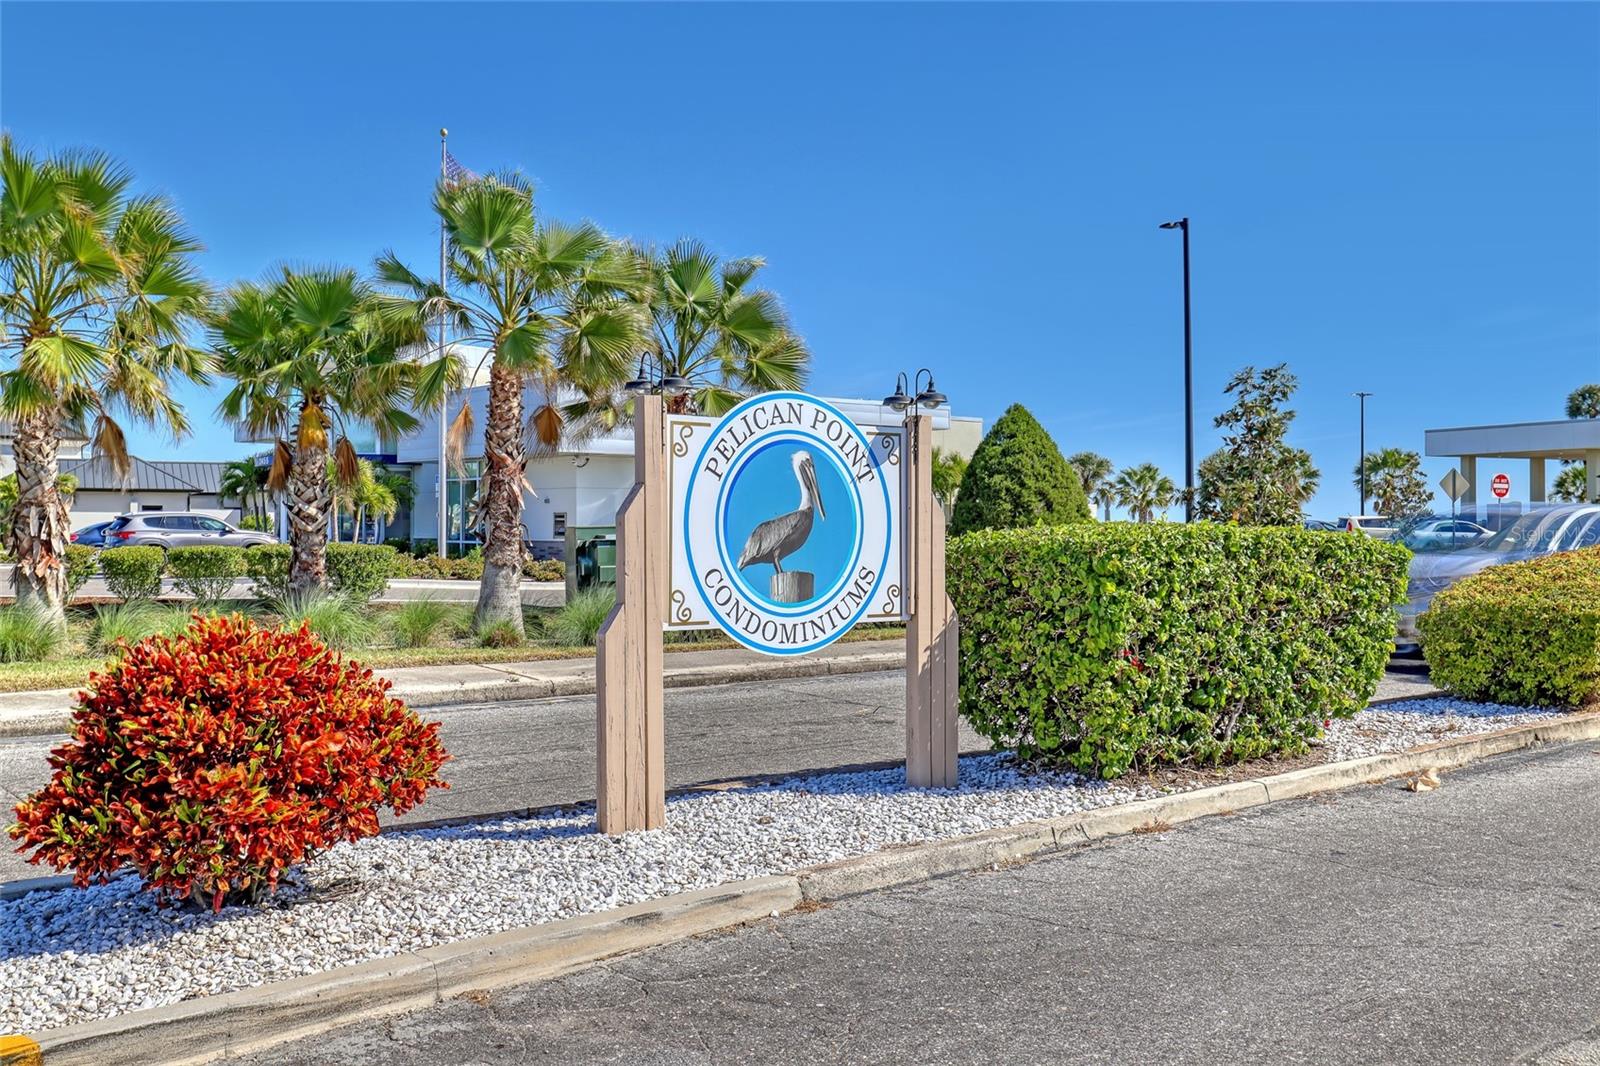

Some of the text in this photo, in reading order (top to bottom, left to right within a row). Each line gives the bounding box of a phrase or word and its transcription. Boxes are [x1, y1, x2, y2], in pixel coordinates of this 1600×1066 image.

[704, 402, 875, 484] PELICAN POINT
[704, 565, 876, 644] CONDOMINIUMS
